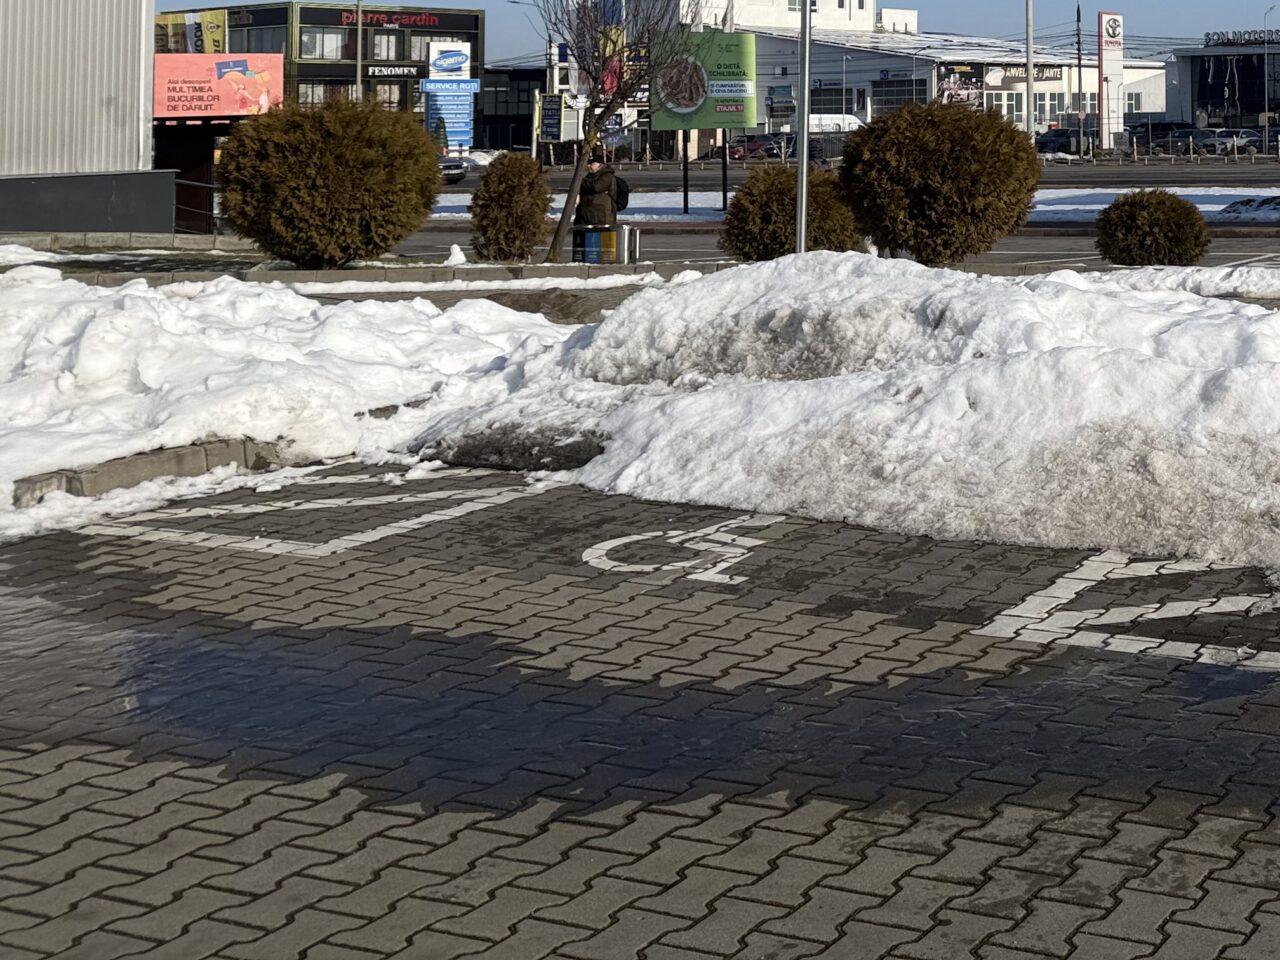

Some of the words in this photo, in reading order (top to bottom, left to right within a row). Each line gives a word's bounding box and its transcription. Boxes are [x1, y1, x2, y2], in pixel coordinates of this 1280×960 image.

[392, 13, 440, 26] cardin
[1232, 29, 1280, 43] MOTORS
[368, 67, 417, 76] FENOMEN
[1043, 68, 1061, 79] JANTE
